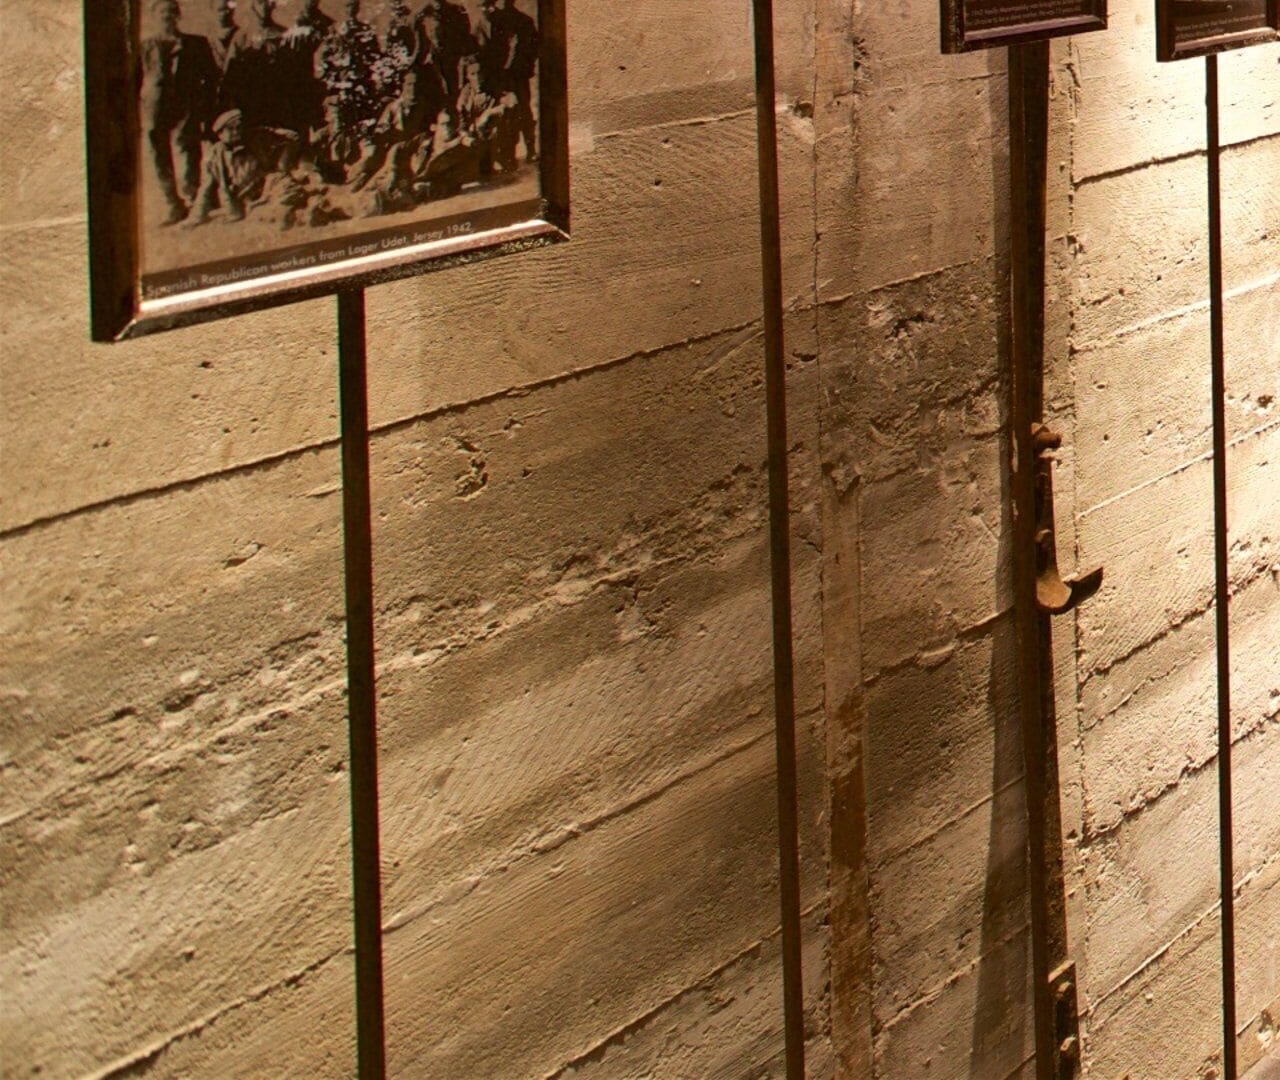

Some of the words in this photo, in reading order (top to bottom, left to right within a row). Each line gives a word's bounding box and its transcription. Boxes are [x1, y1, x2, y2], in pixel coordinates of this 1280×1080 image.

[146, 278, 198, 298] Spanish
[201, 264, 268, 285] Republican
[271, 254, 317, 271] workers
[319, 247, 346, 261] from
[348, 240, 378, 257] Lager
[412, 229, 443, 244] Jersey
